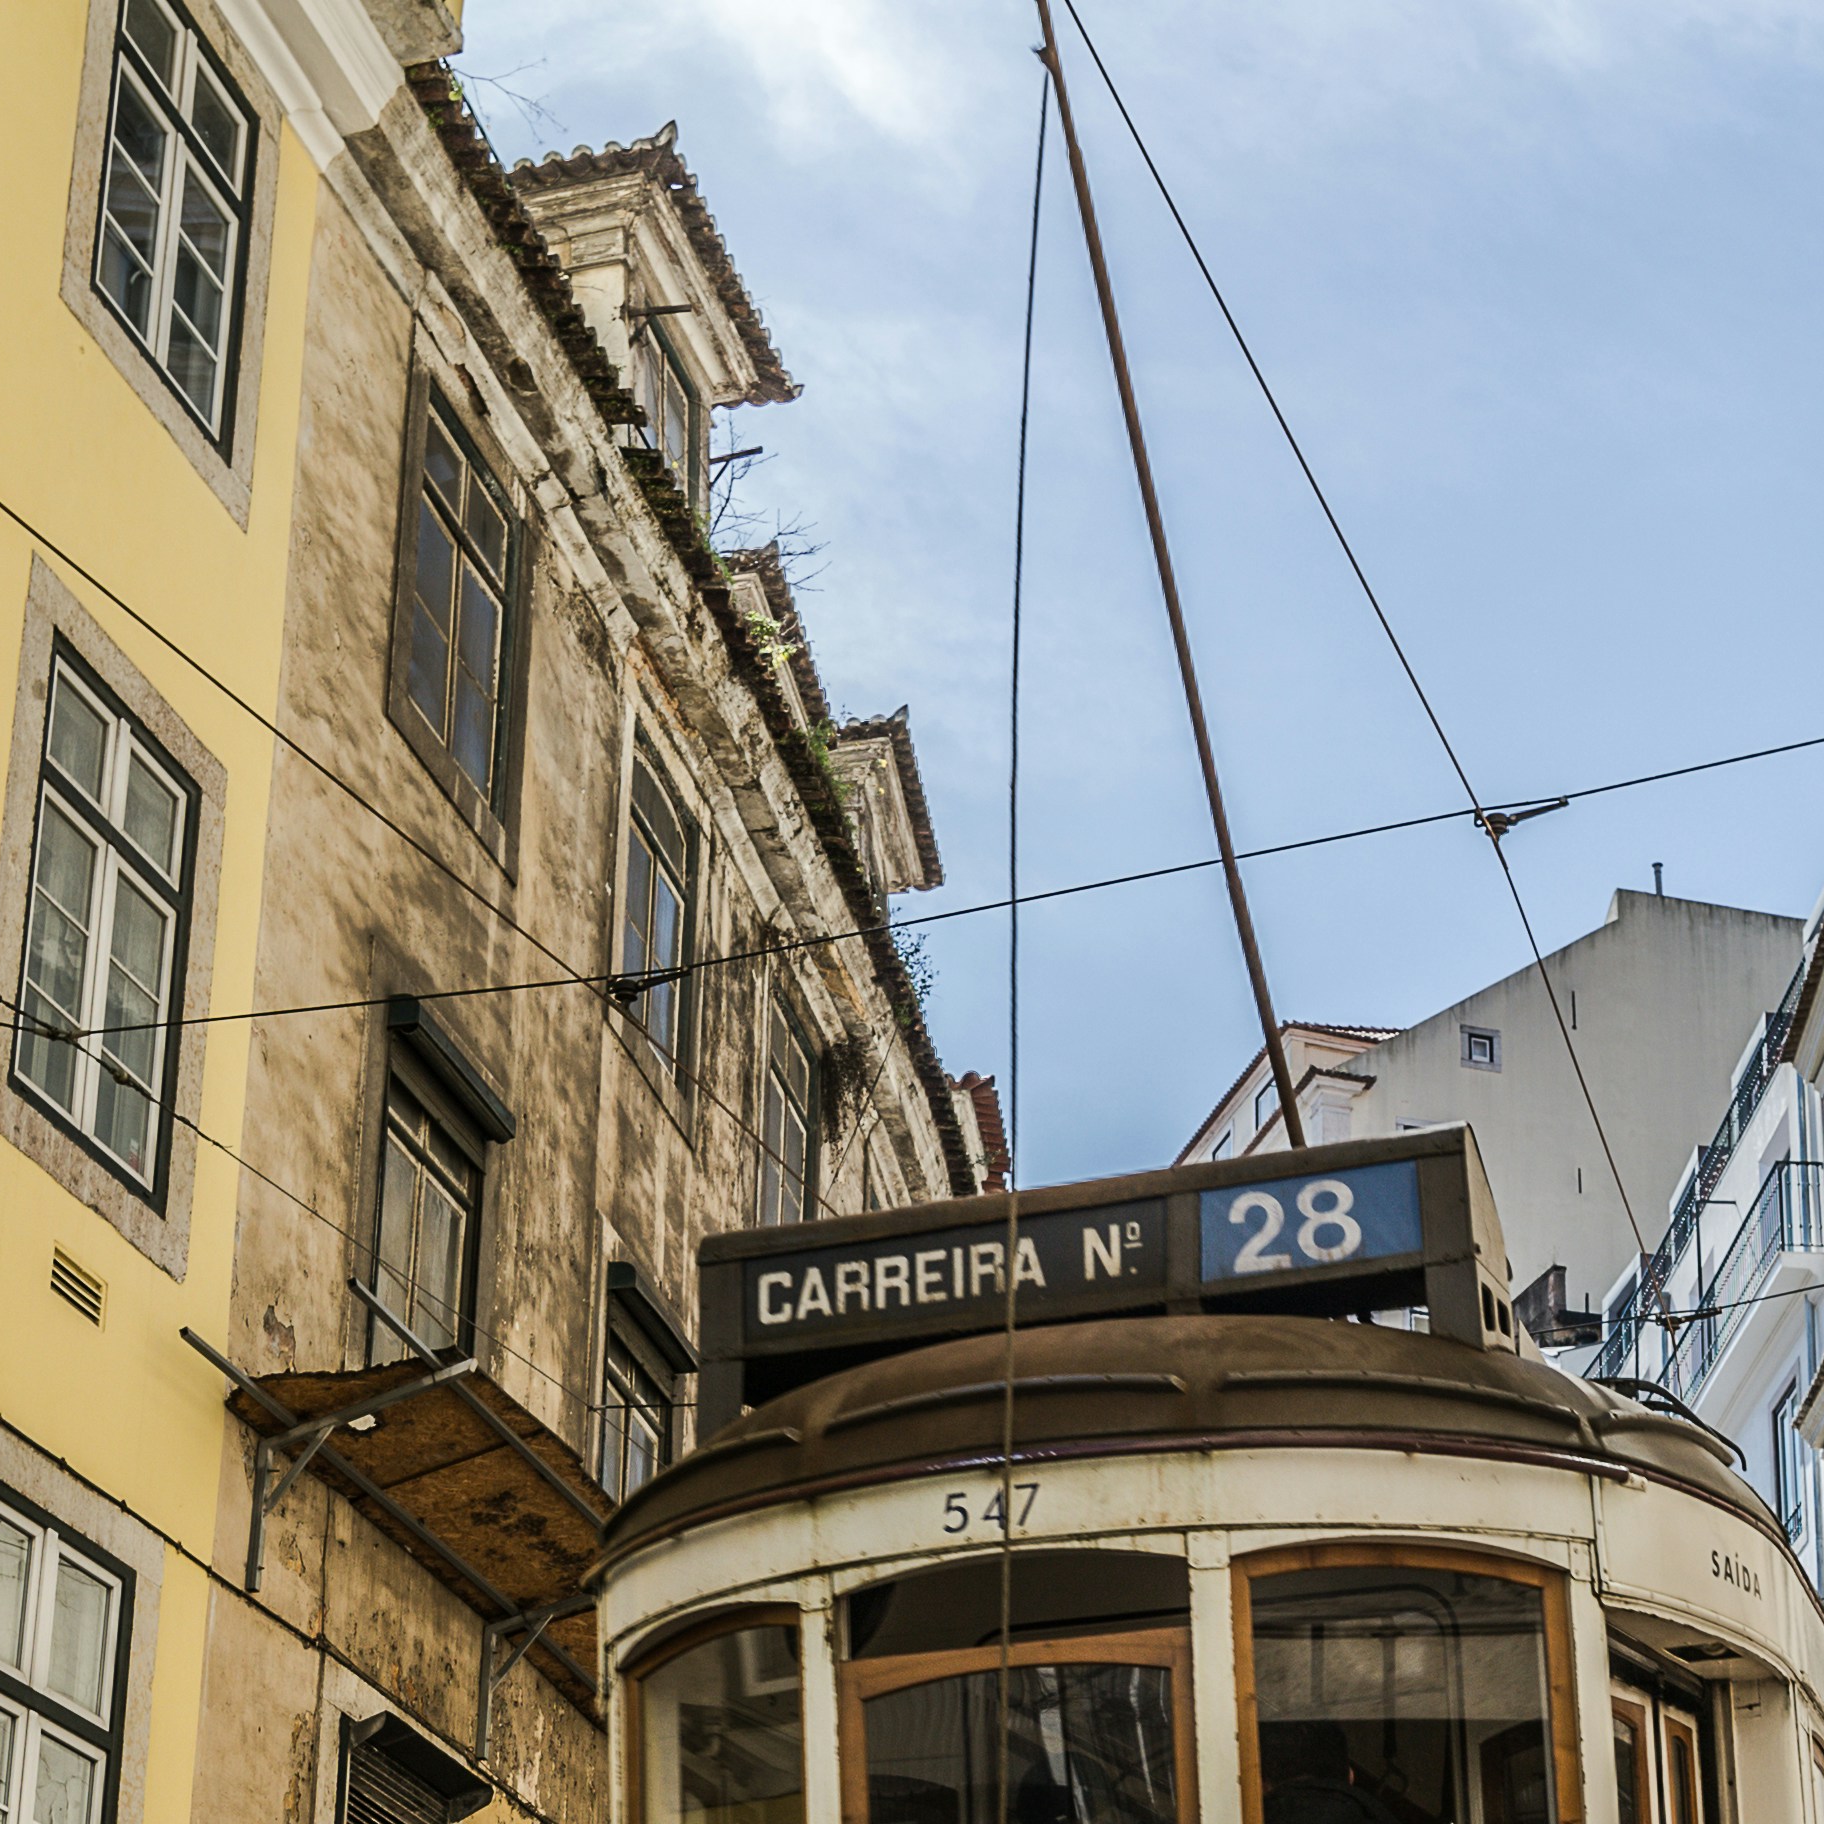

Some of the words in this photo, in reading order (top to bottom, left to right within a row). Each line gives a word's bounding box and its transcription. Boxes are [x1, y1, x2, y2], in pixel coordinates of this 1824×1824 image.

[757, 1236, 1047, 1326] CARREIRA
[1228, 1178, 1363, 1274] 28
[942, 1482, 1041, 1534] 547
